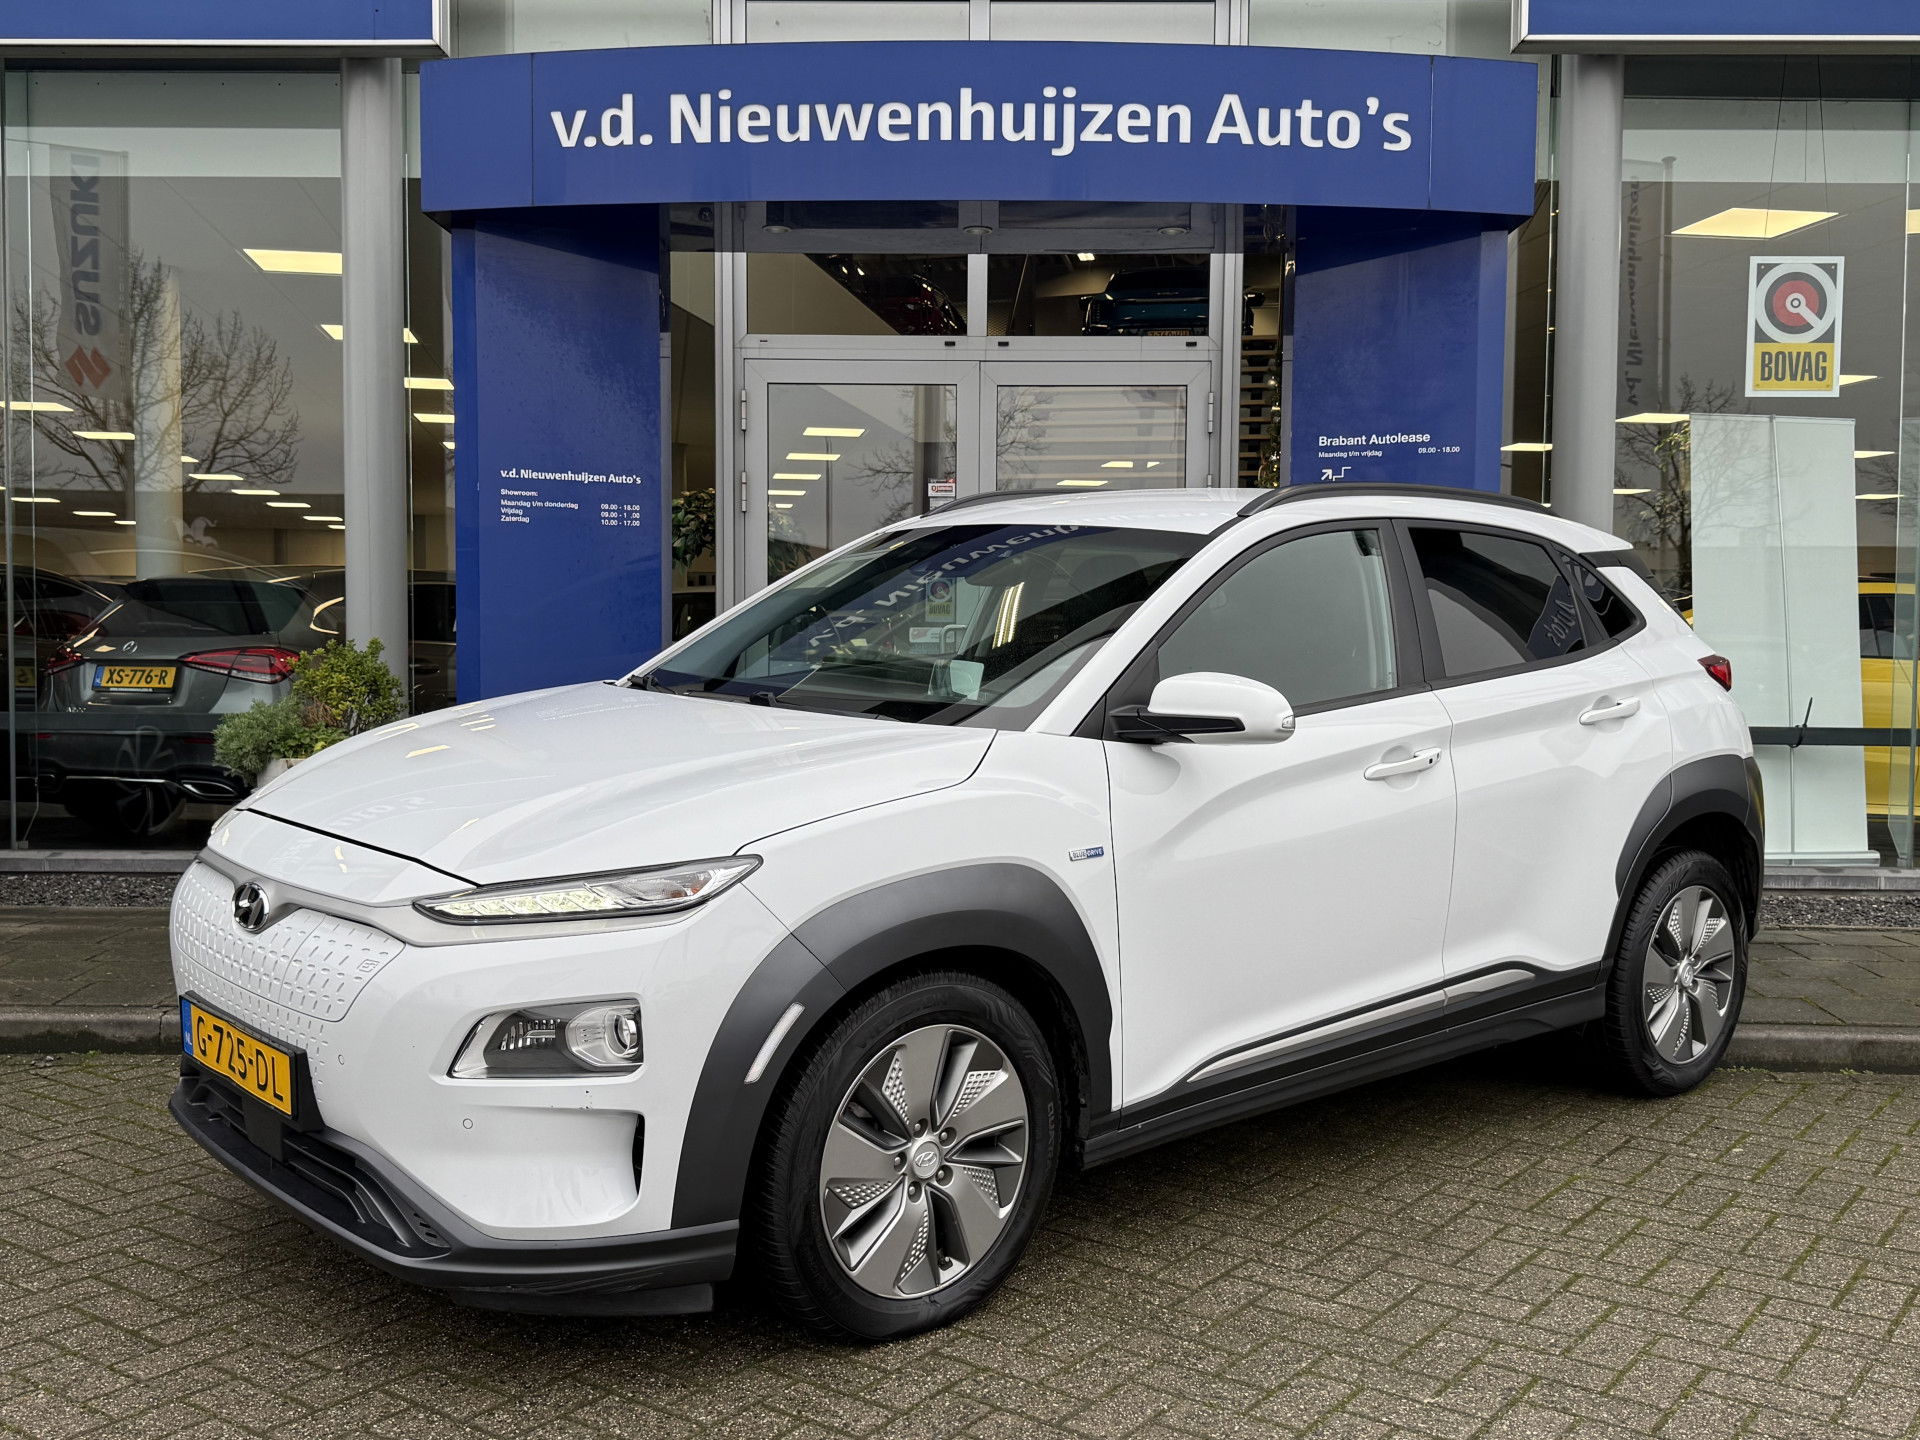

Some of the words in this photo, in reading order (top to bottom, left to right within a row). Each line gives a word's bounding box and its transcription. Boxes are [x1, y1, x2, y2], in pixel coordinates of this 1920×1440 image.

[550, 92, 654, 148] v.d.
[669, 85, 1192, 157] Nieuwenhuijzen
[1205, 93, 1413, 151] Auto's
[1759, 351, 1828, 382] BOVAG
[1318, 435, 1367, 447] Brabant
[1369, 432, 1431, 446] Autolease
[1318, 450, 1348, 458] Maandag
[1361, 449, 1383, 458] vrijdag
[1418, 446, 1437, 454] 09.00
[500, 468, 519, 478] v.d.
[520, 469, 607, 484] Nieuwenhuijzen
[608, 473, 642, 485] Auto's
[500, 488, 539, 497] Showroom:
[500, 499, 531, 508] Maandag
[544, 501, 579, 510] donderdag
[600, 503, 618, 511] 09.00
[500, 507, 523, 516] Vrijdag
[600, 511, 618, 519] 09.00
[500, 515, 530, 523] Zaterdag
[600, 519, 618, 527] 10.00
[623, 520, 641, 528] 17.00
[105, 668, 169, 685] XS-776-R
[196, 1014, 284, 1103] G-725-DL
